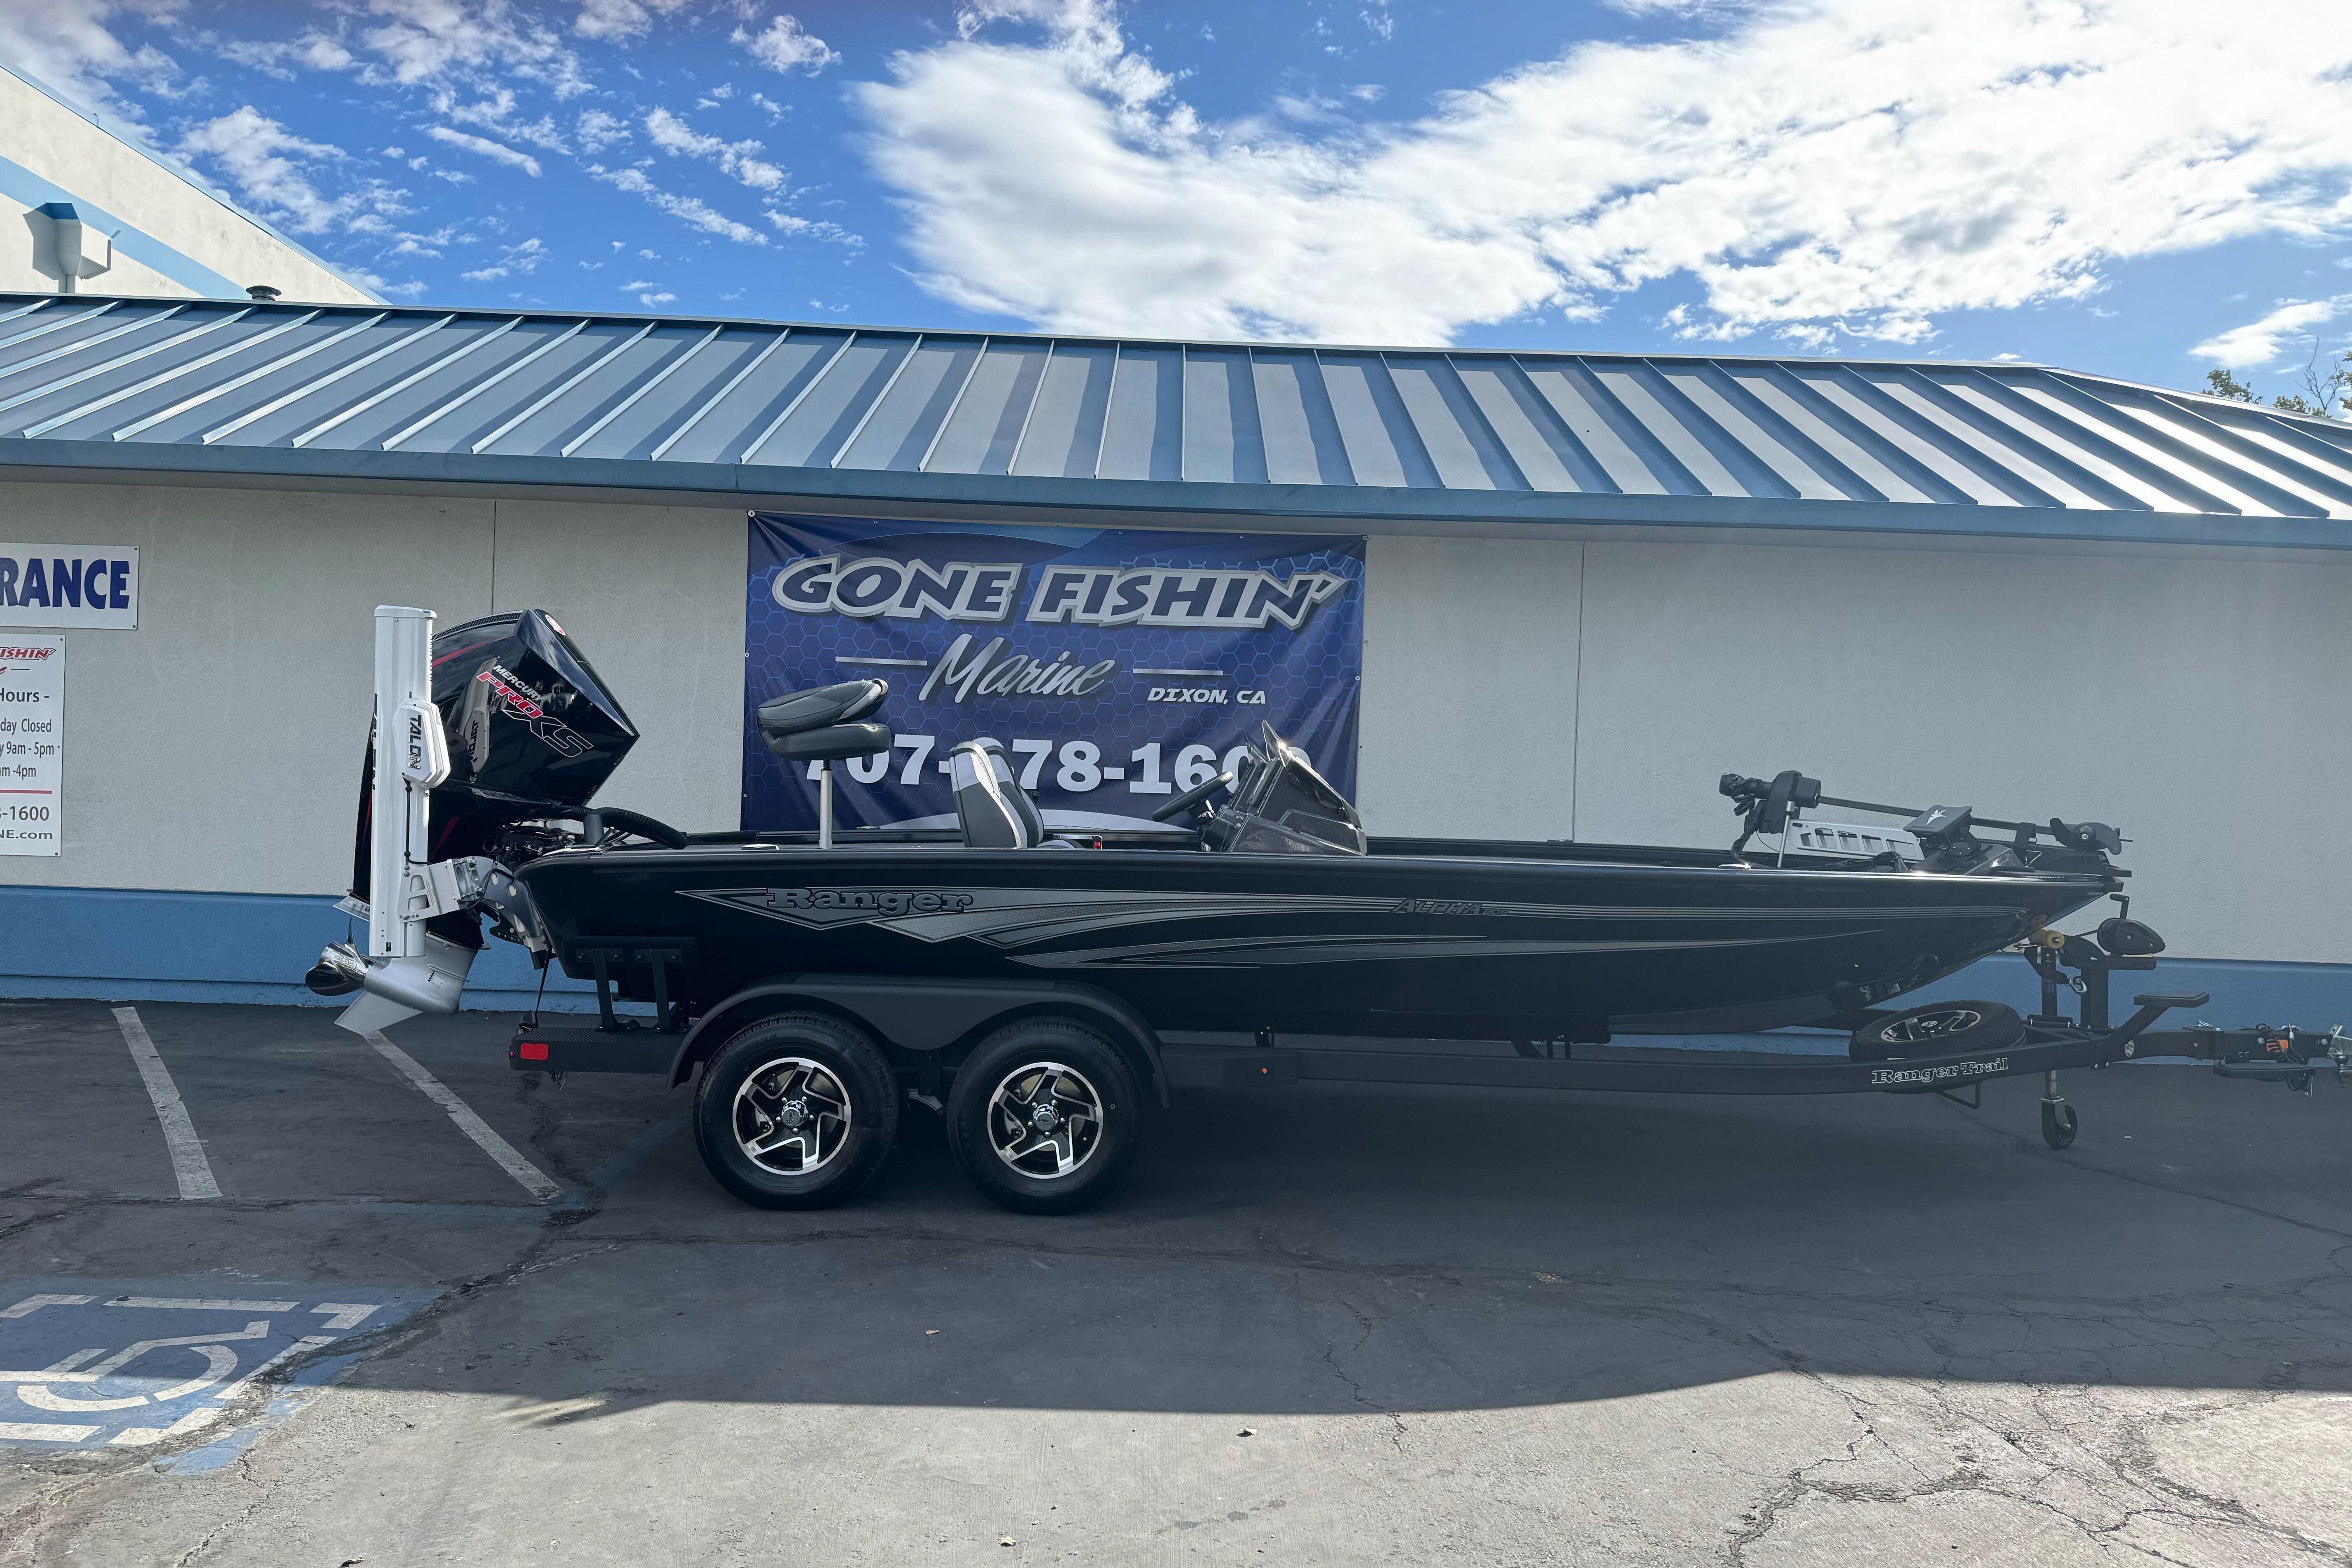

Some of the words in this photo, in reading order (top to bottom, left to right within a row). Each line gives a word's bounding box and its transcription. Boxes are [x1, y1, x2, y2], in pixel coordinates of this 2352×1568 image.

[0, 558, 130, 609] RANCE
[772, 554, 1022, 620] GONE
[1026, 565, 1346, 630] FISHIN'
[493, 665, 546, 701] MERCURY
[919, 633, 1115, 703] Marine
[476, 671, 544, 719] PRO
[1147, 688, 1228, 705] DIXON,
[1237, 690, 1266, 704] CA
[0, 717, 17, 735] day
[21, 718, 51, 733] Closed
[408, 714, 422, 770] TALON
[501, 709, 594, 758] XS
[7, 741, 26, 755] 9am
[34, 742, 54, 759] 5pm
[0, 805, 49, 821] -1600
[766, 887, 974, 917] Ranger
[1391, 898, 1482, 915] ALPHA
[1872, 1065, 1959, 1084] Ranger
[1960, 1058, 2008, 1075] Trail
